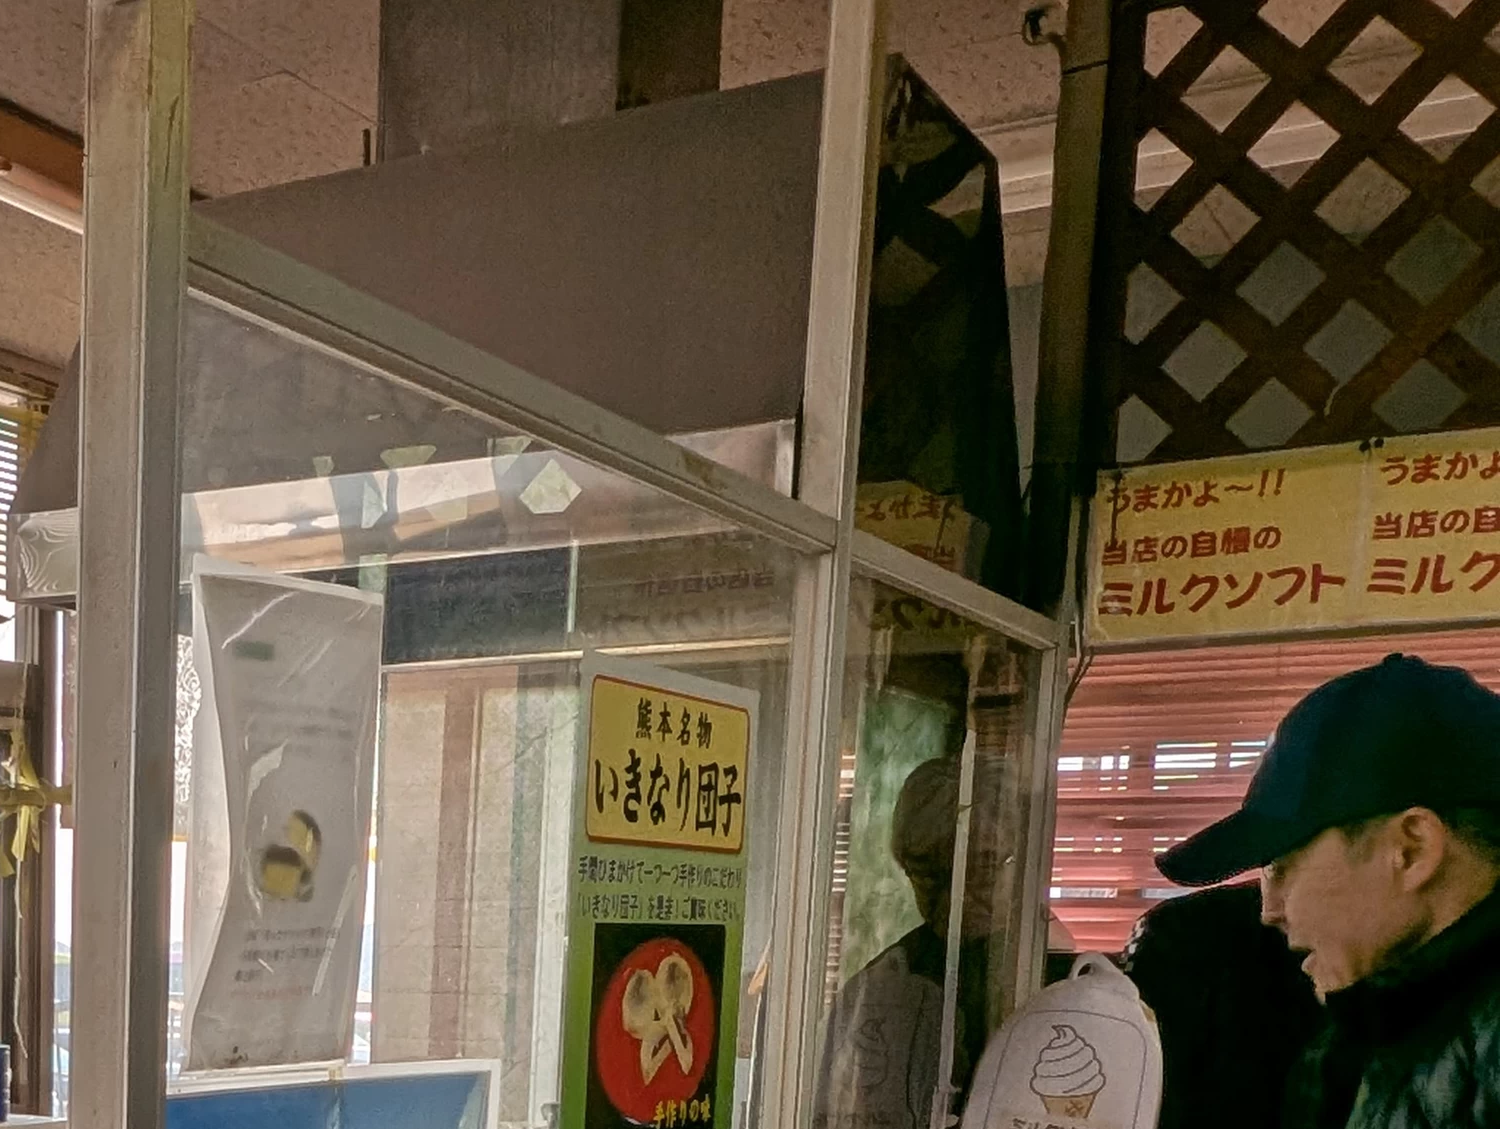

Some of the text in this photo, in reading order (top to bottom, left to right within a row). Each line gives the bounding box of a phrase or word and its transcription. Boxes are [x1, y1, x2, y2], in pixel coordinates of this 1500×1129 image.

[1101, 525, 1281, 566] 当店の自慢の
[1372, 505, 1500, 540] 当店の自
[1098, 562, 1345, 616] ミルクソフト
[1366, 550, 1500, 595] ミルク
[635, 697, 713, 749] 熊本名物
[594, 748, 742, 837] いきなり団子
